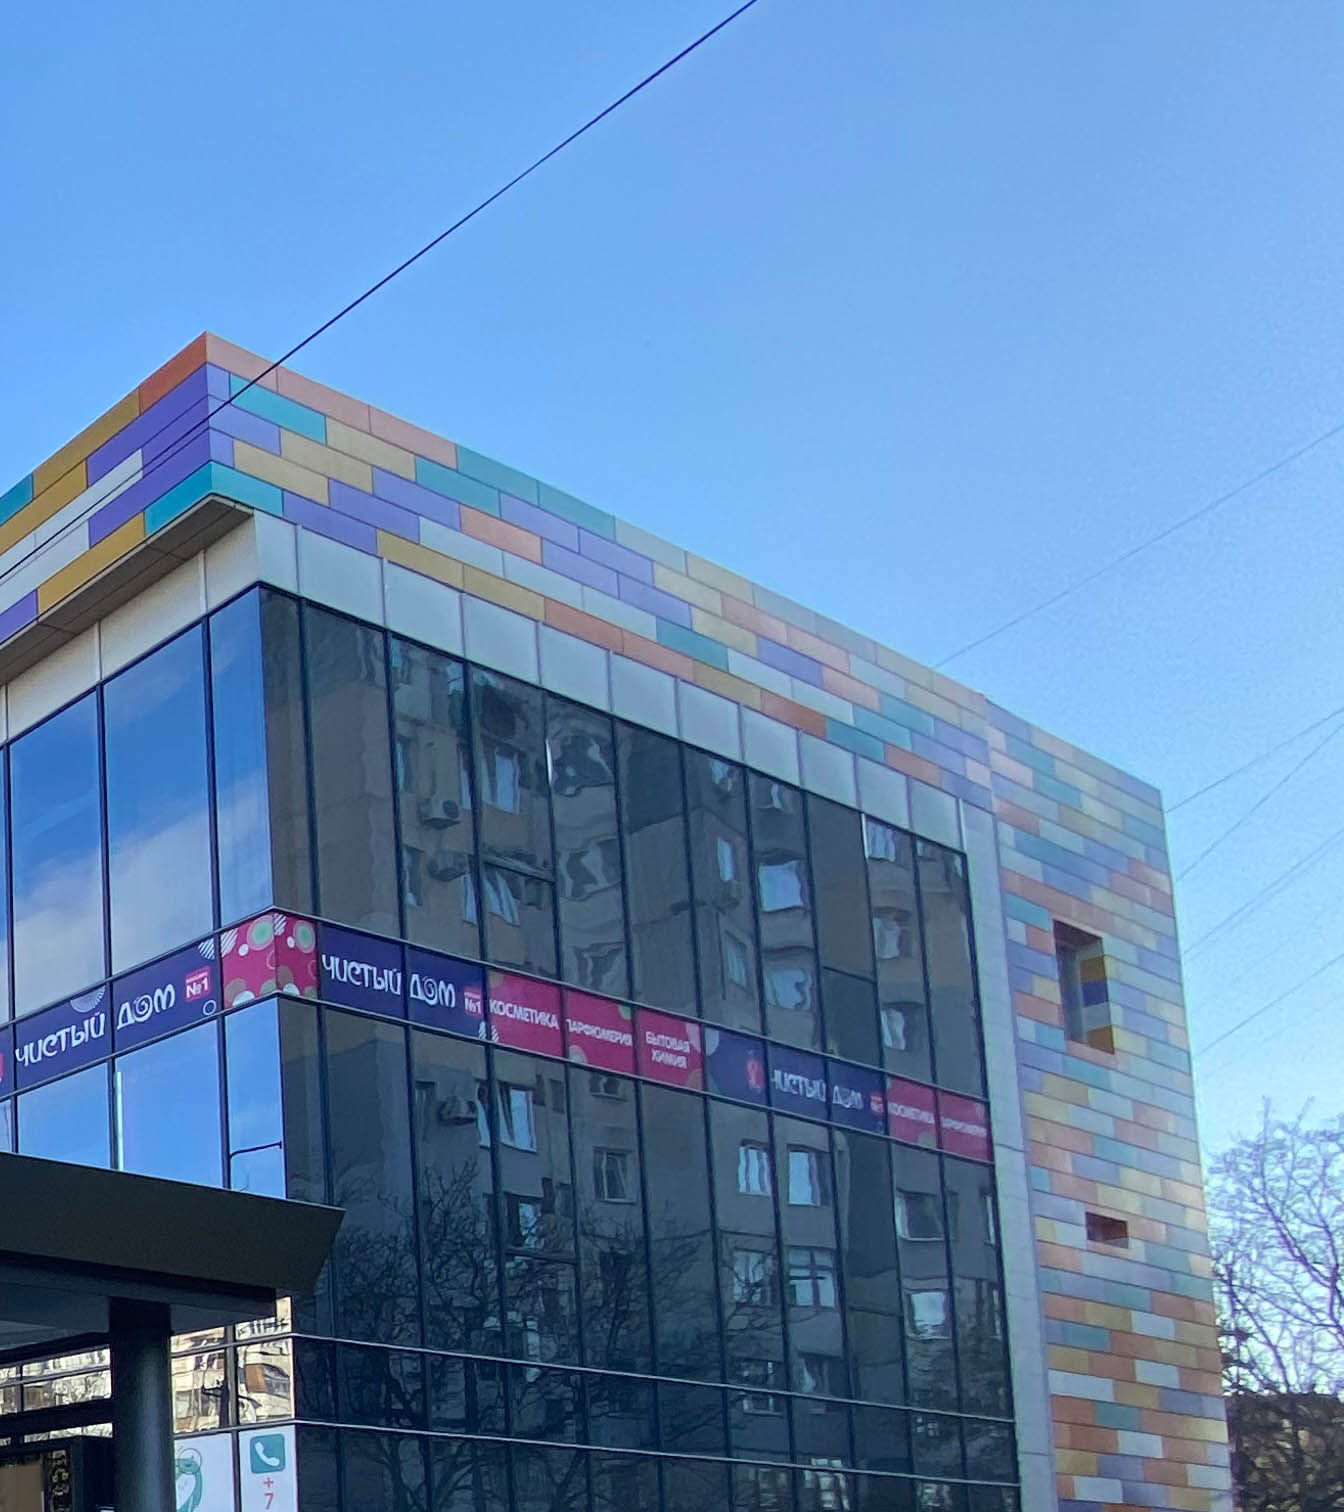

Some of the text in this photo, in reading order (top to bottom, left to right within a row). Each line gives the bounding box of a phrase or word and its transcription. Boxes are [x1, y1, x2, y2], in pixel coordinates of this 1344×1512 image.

[322, 954, 455, 1008] ЧИСТЫЙ ДОМ
[15, 984, 175, 1066] ЧИСТЫЙ ДОМ
[489, 1000, 559, 1030] КОСМЕТИКА
[645, 1032, 690, 1053] БЫТОВАЯ
[651, 1050, 687, 1069] ХИМИЯ
